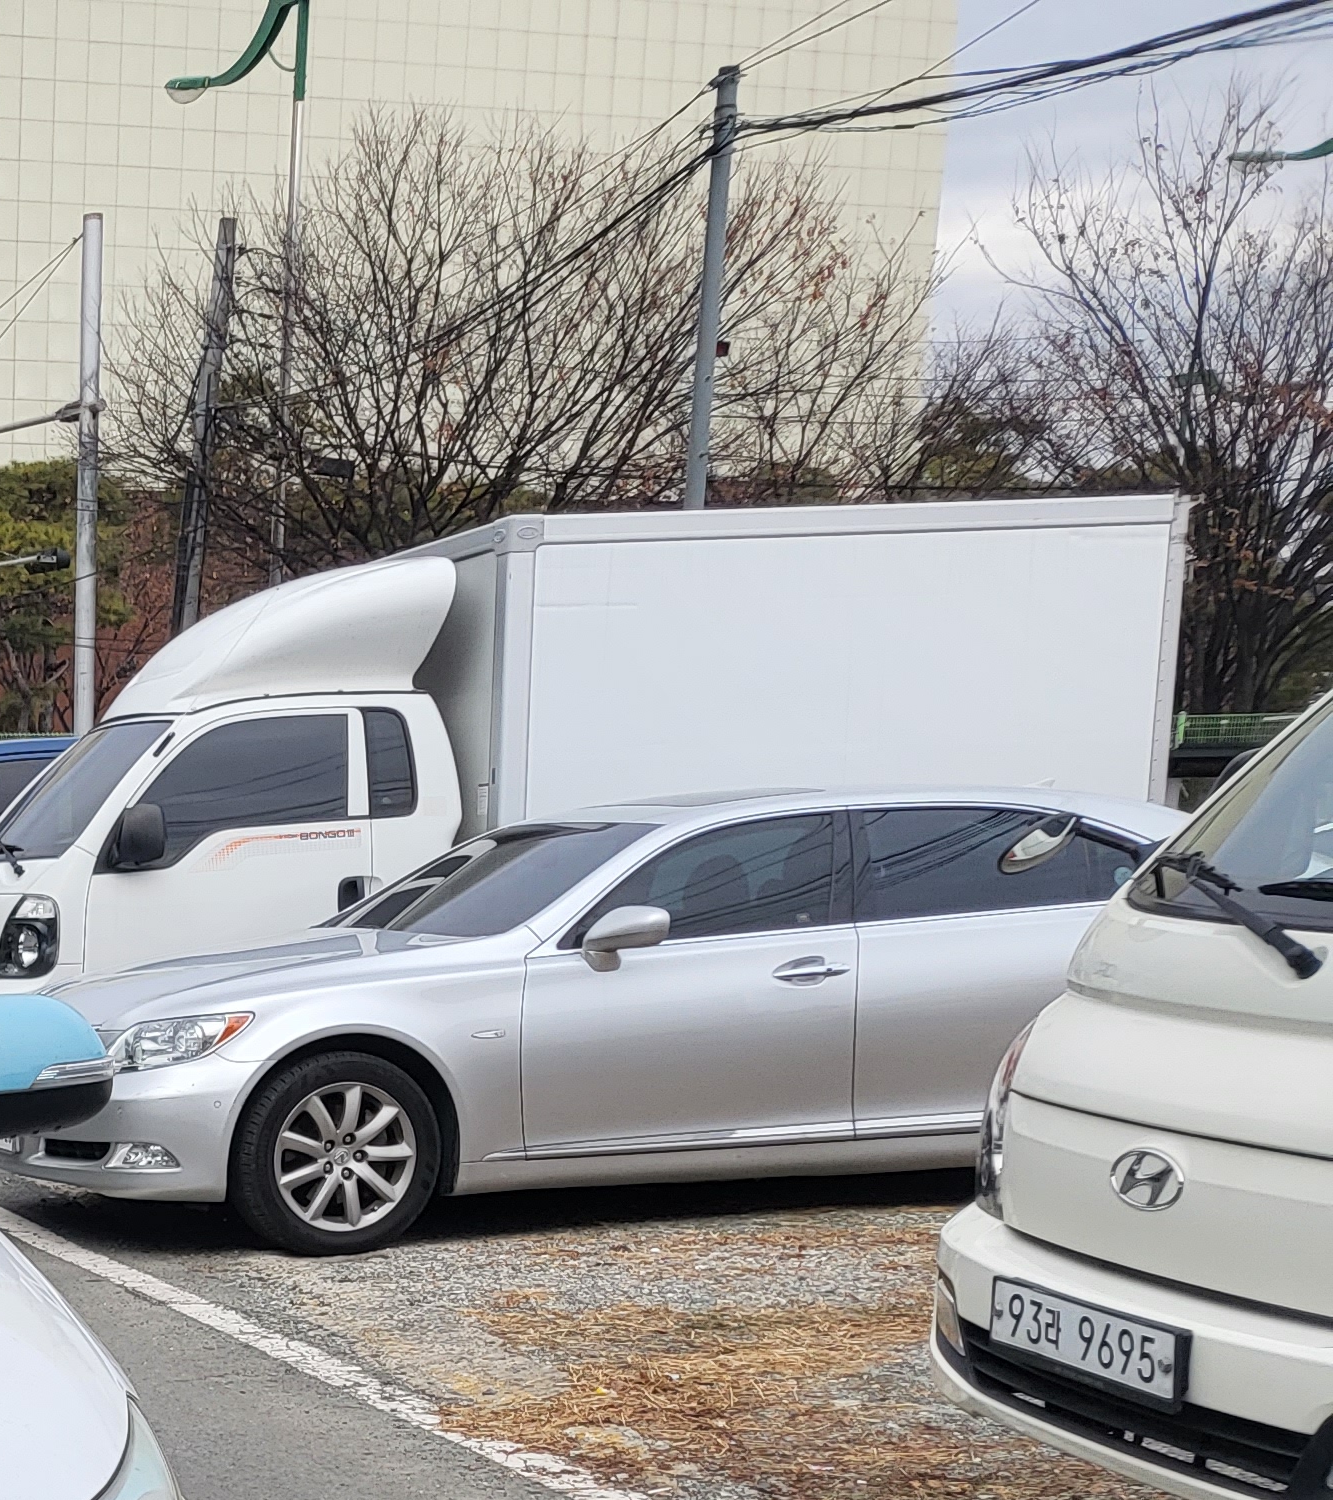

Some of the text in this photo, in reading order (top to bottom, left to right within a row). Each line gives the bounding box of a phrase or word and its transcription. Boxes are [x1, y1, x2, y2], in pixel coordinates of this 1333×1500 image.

[299, 830, 346, 841] BONGO
[1008, 1293, 1156, 1384] 93라 9695
